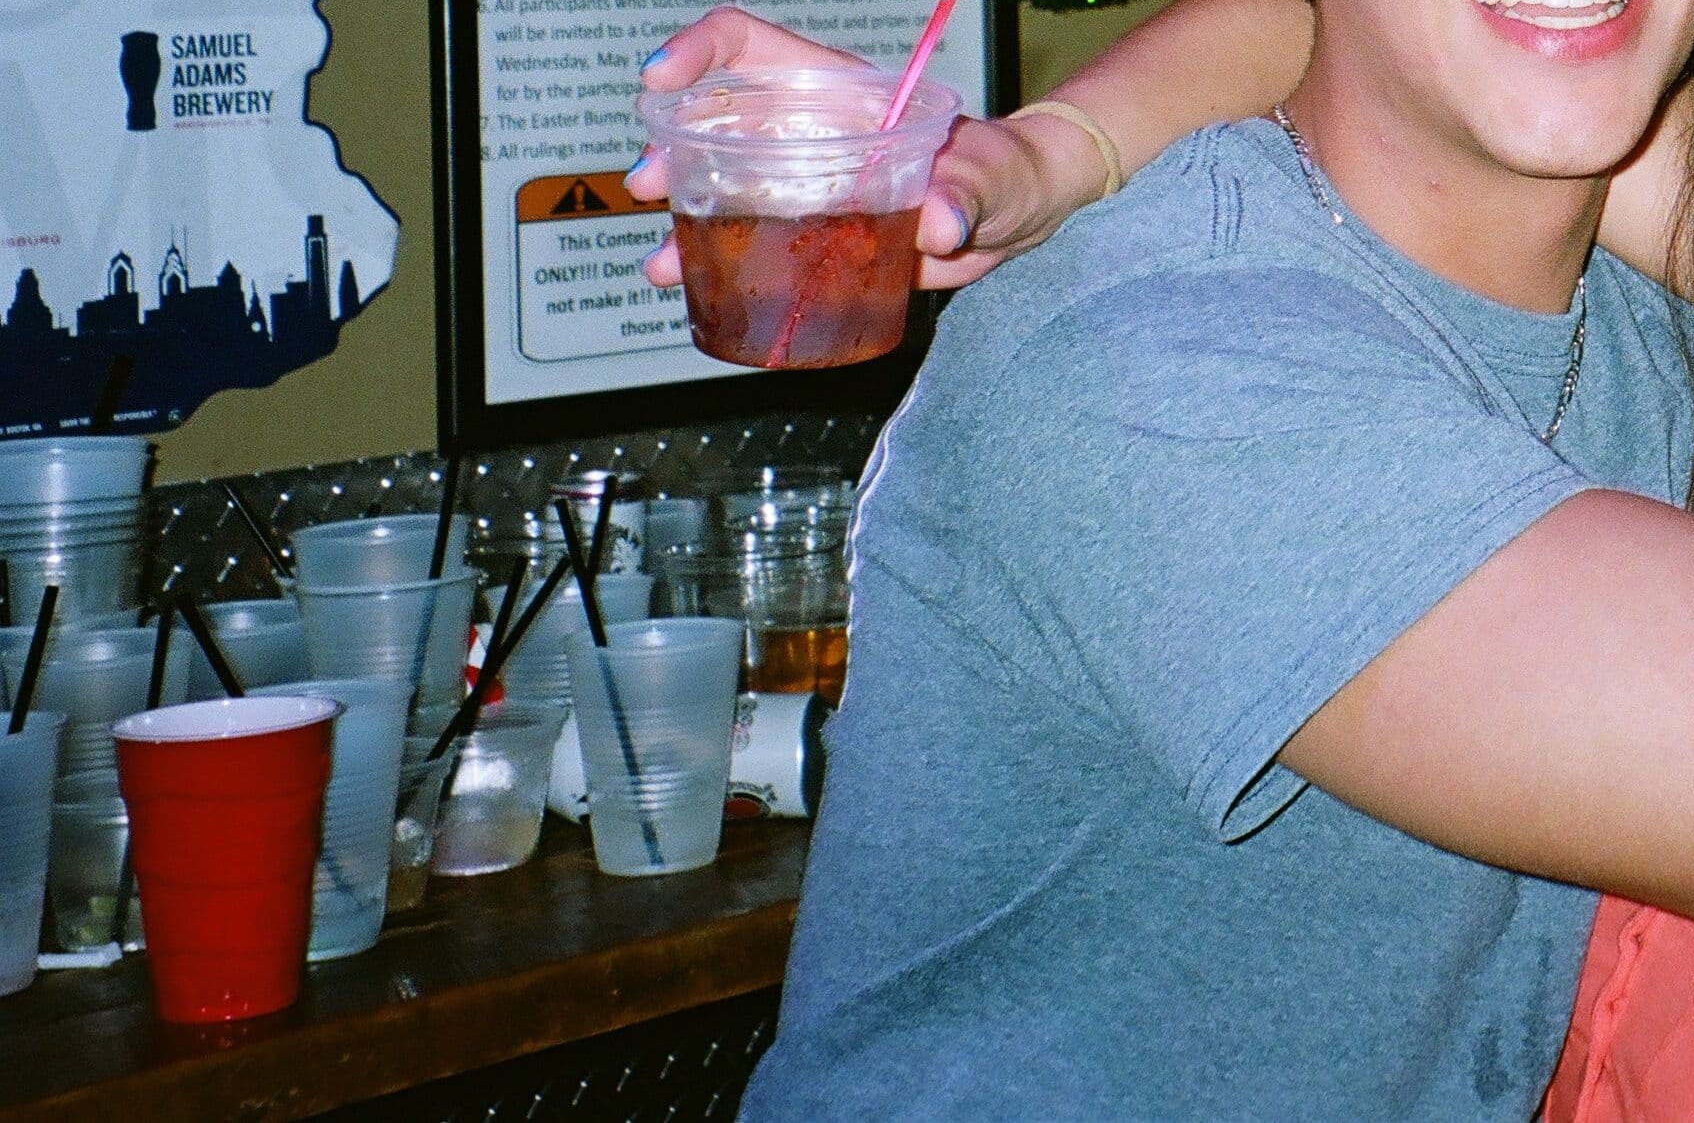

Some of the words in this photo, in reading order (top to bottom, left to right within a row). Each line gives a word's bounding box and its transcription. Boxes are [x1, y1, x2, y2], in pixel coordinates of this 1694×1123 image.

[171, 33, 257, 59] SAMUEL
[172, 62, 247, 88] ADAMS
[173, 90, 274, 117] BREWERY
[558, 235, 591, 252] This
[596, 229, 658, 249] Contest
[534, 262, 598, 285] ONLY!!!
[546, 298, 575, 314] not
[579, 292, 624, 311] make
[621, 319, 666, 337] those
